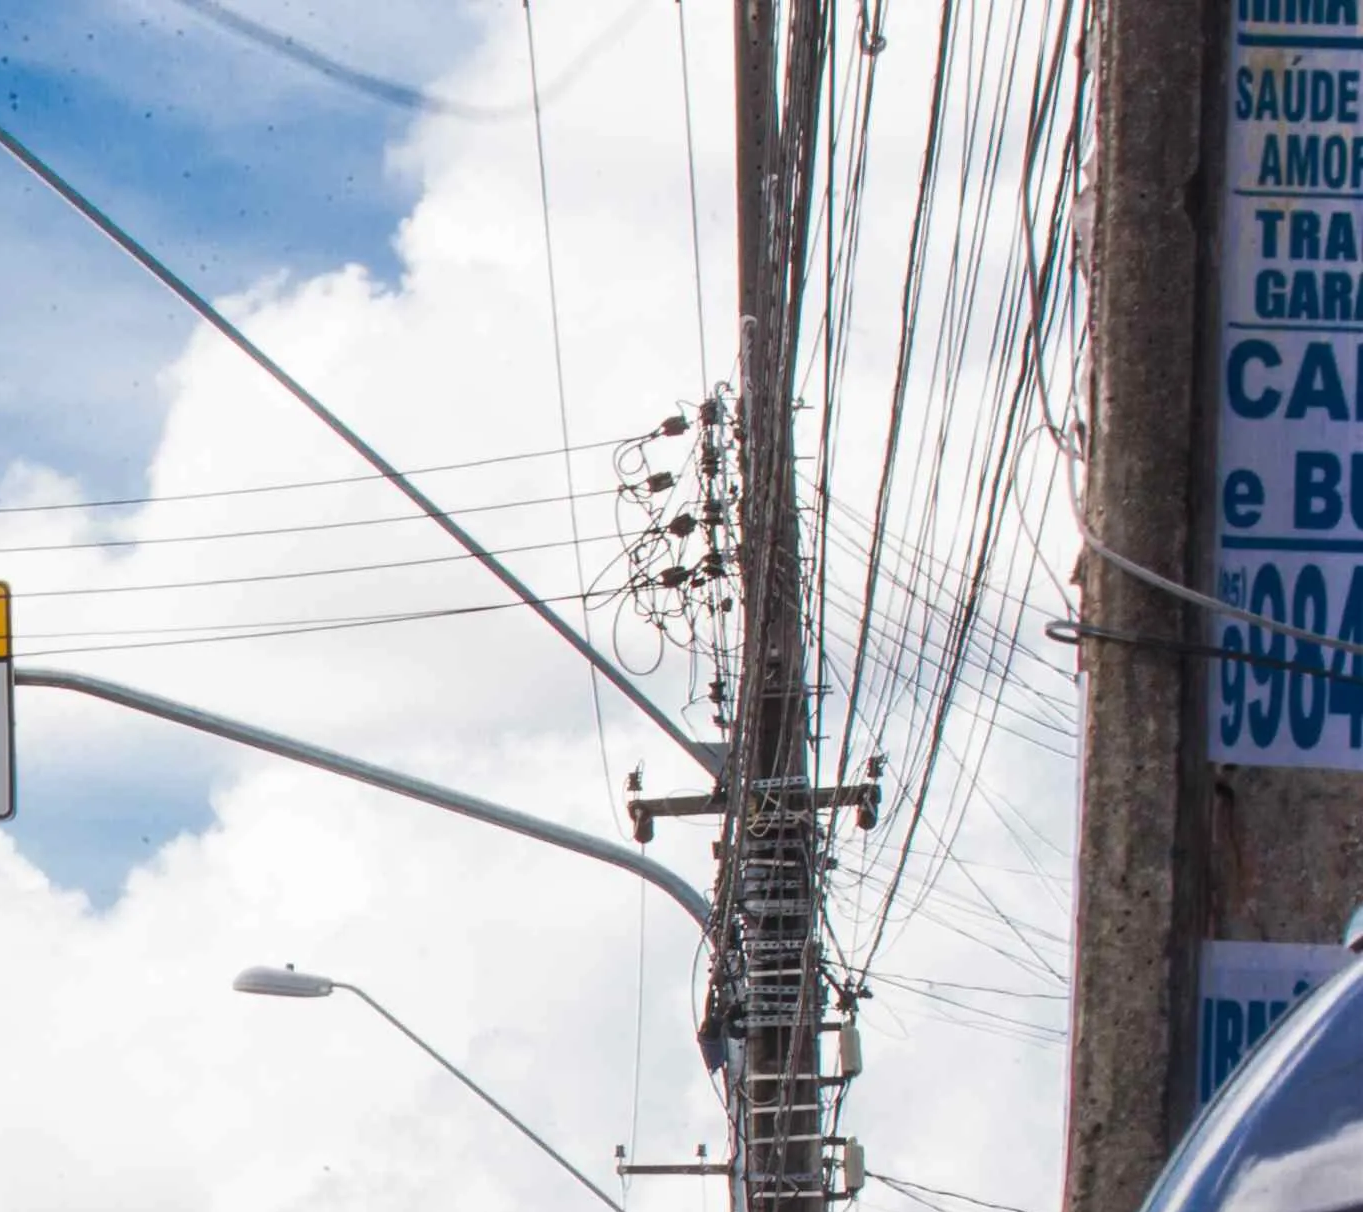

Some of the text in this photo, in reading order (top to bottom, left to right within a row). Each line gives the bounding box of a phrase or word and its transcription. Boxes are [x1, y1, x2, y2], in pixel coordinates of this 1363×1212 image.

[1235, 56, 1359, 122] SAÚDE
[1255, 209, 1363, 261] TRA
[1227, 339, 1363, 422] CA
[1224, 469, 1265, 528] e
